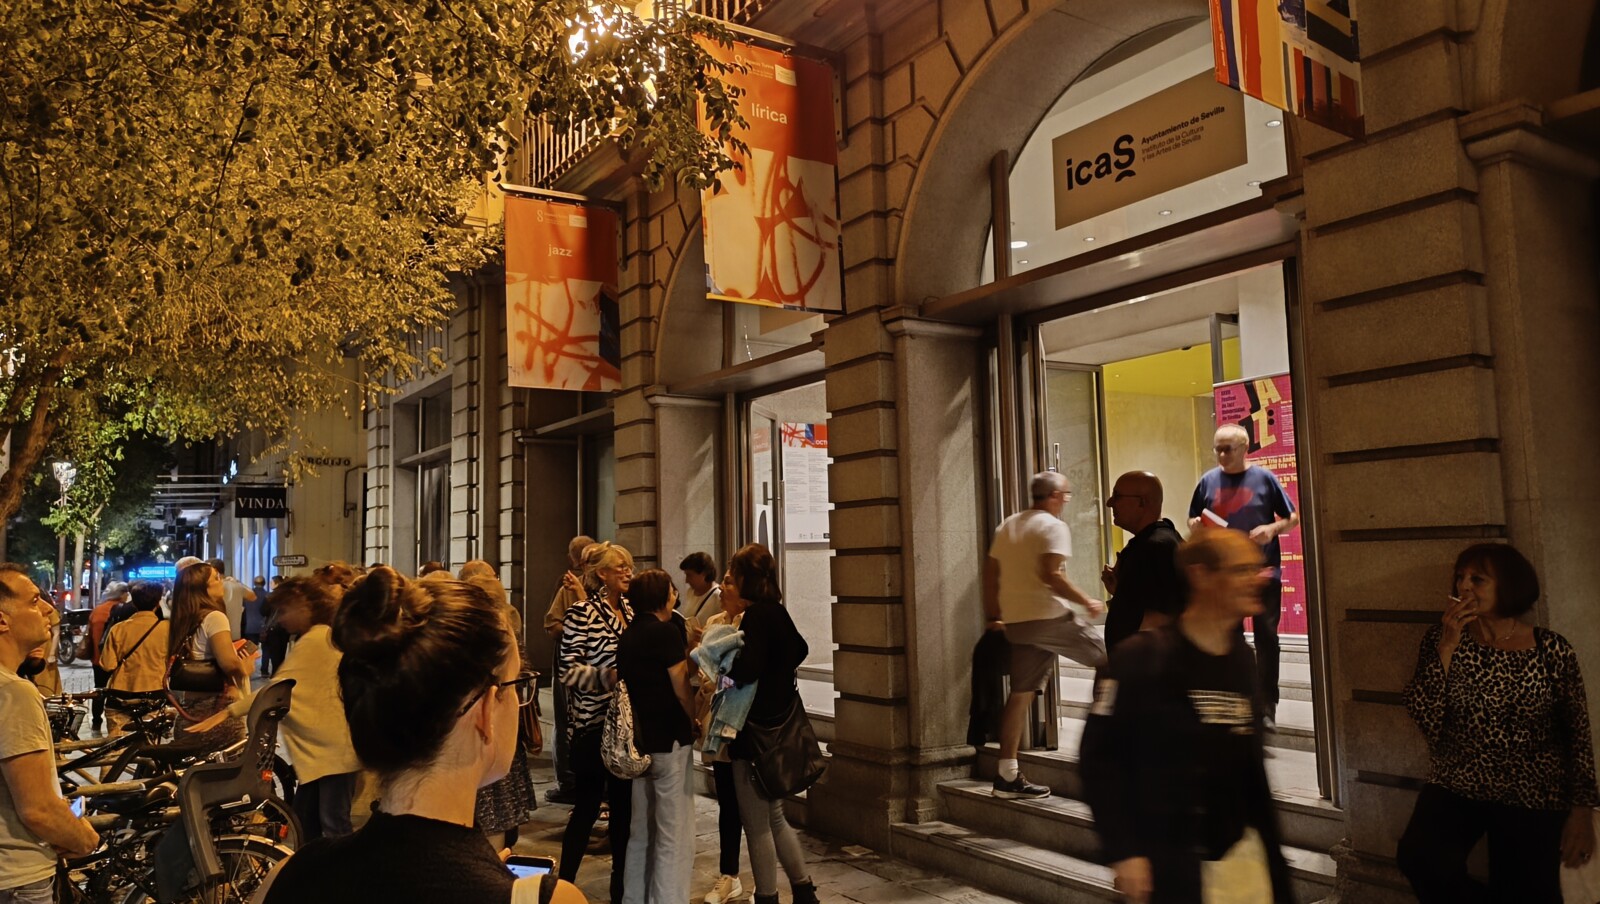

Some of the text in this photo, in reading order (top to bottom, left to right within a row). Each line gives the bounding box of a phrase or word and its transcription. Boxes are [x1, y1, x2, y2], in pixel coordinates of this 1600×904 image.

[751, 102, 788, 125] lírica
[1141, 106, 1225, 146] Ayuntamiento de Sevilla
[1141, 125, 1205, 155] Instituto de la Cultura
[1146, 152, 1155, 160] las
[1155, 146, 1172, 156] Artes
[1172, 142, 1181, 150] de
[1181, 134, 1202, 147] Sevilla
[547, 243, 573, 257] jazz
[237, 497, 284, 509] VINDA
